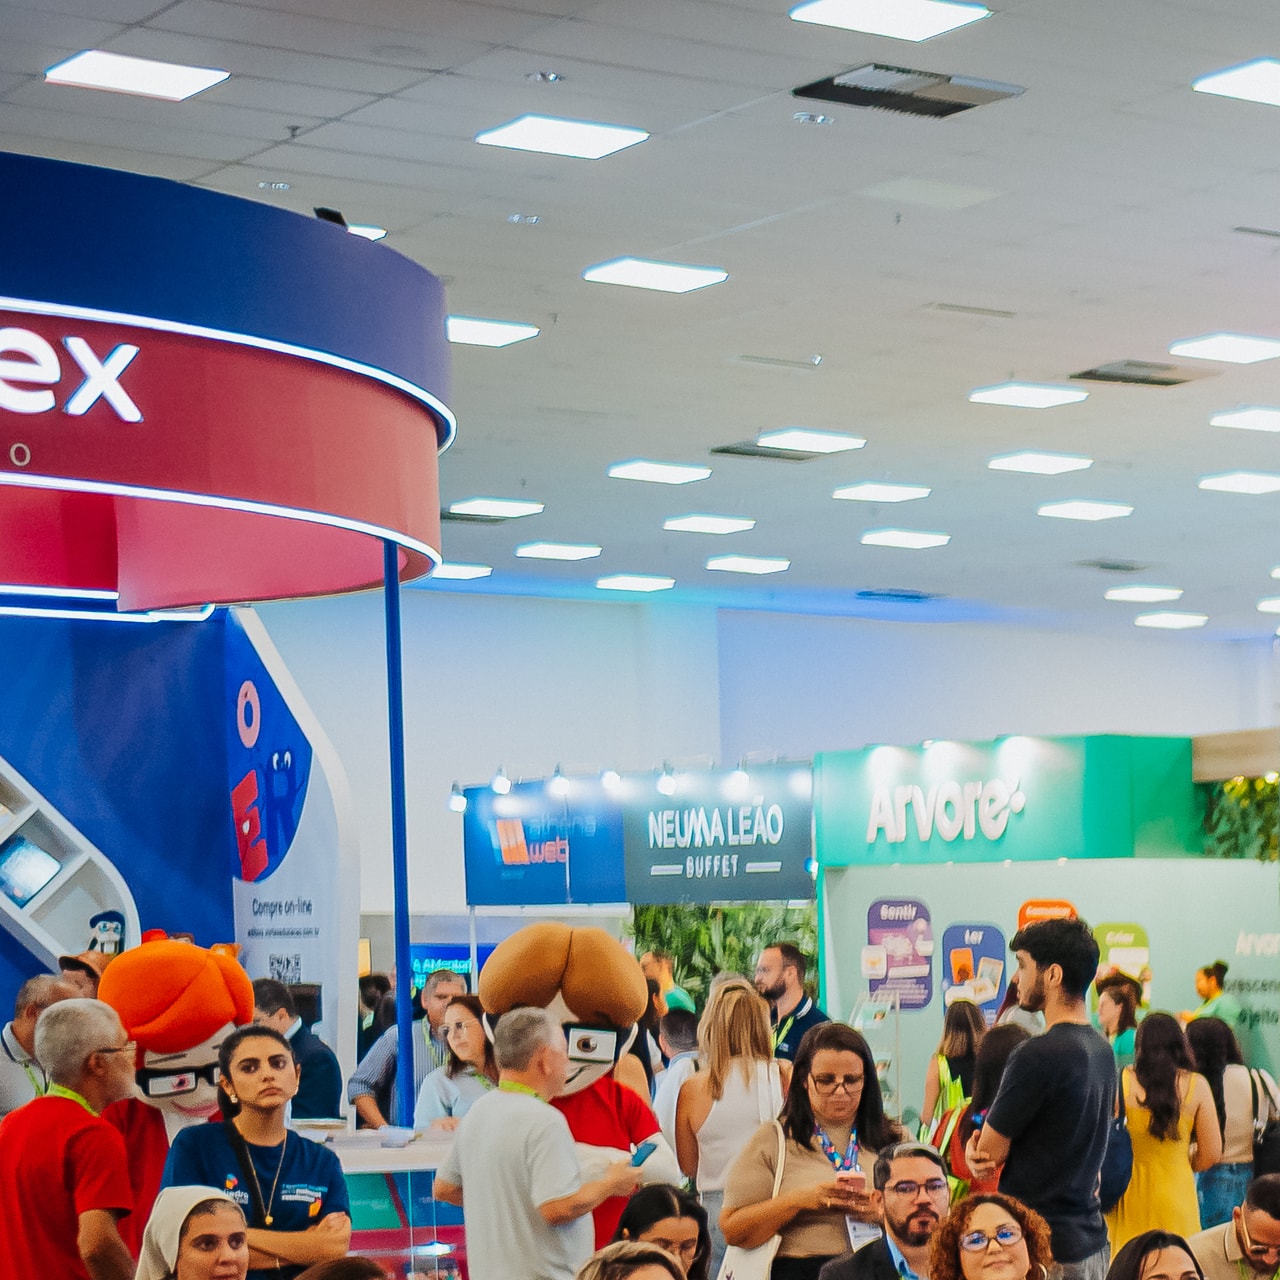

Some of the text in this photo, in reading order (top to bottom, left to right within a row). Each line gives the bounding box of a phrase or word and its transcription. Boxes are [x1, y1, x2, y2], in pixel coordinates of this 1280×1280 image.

[648, 795, 784, 849] NEUMA LEÃO
[530, 836, 568, 864] web
[685, 855, 739, 879] BUFFET
[252, 898, 283, 919] Compre
